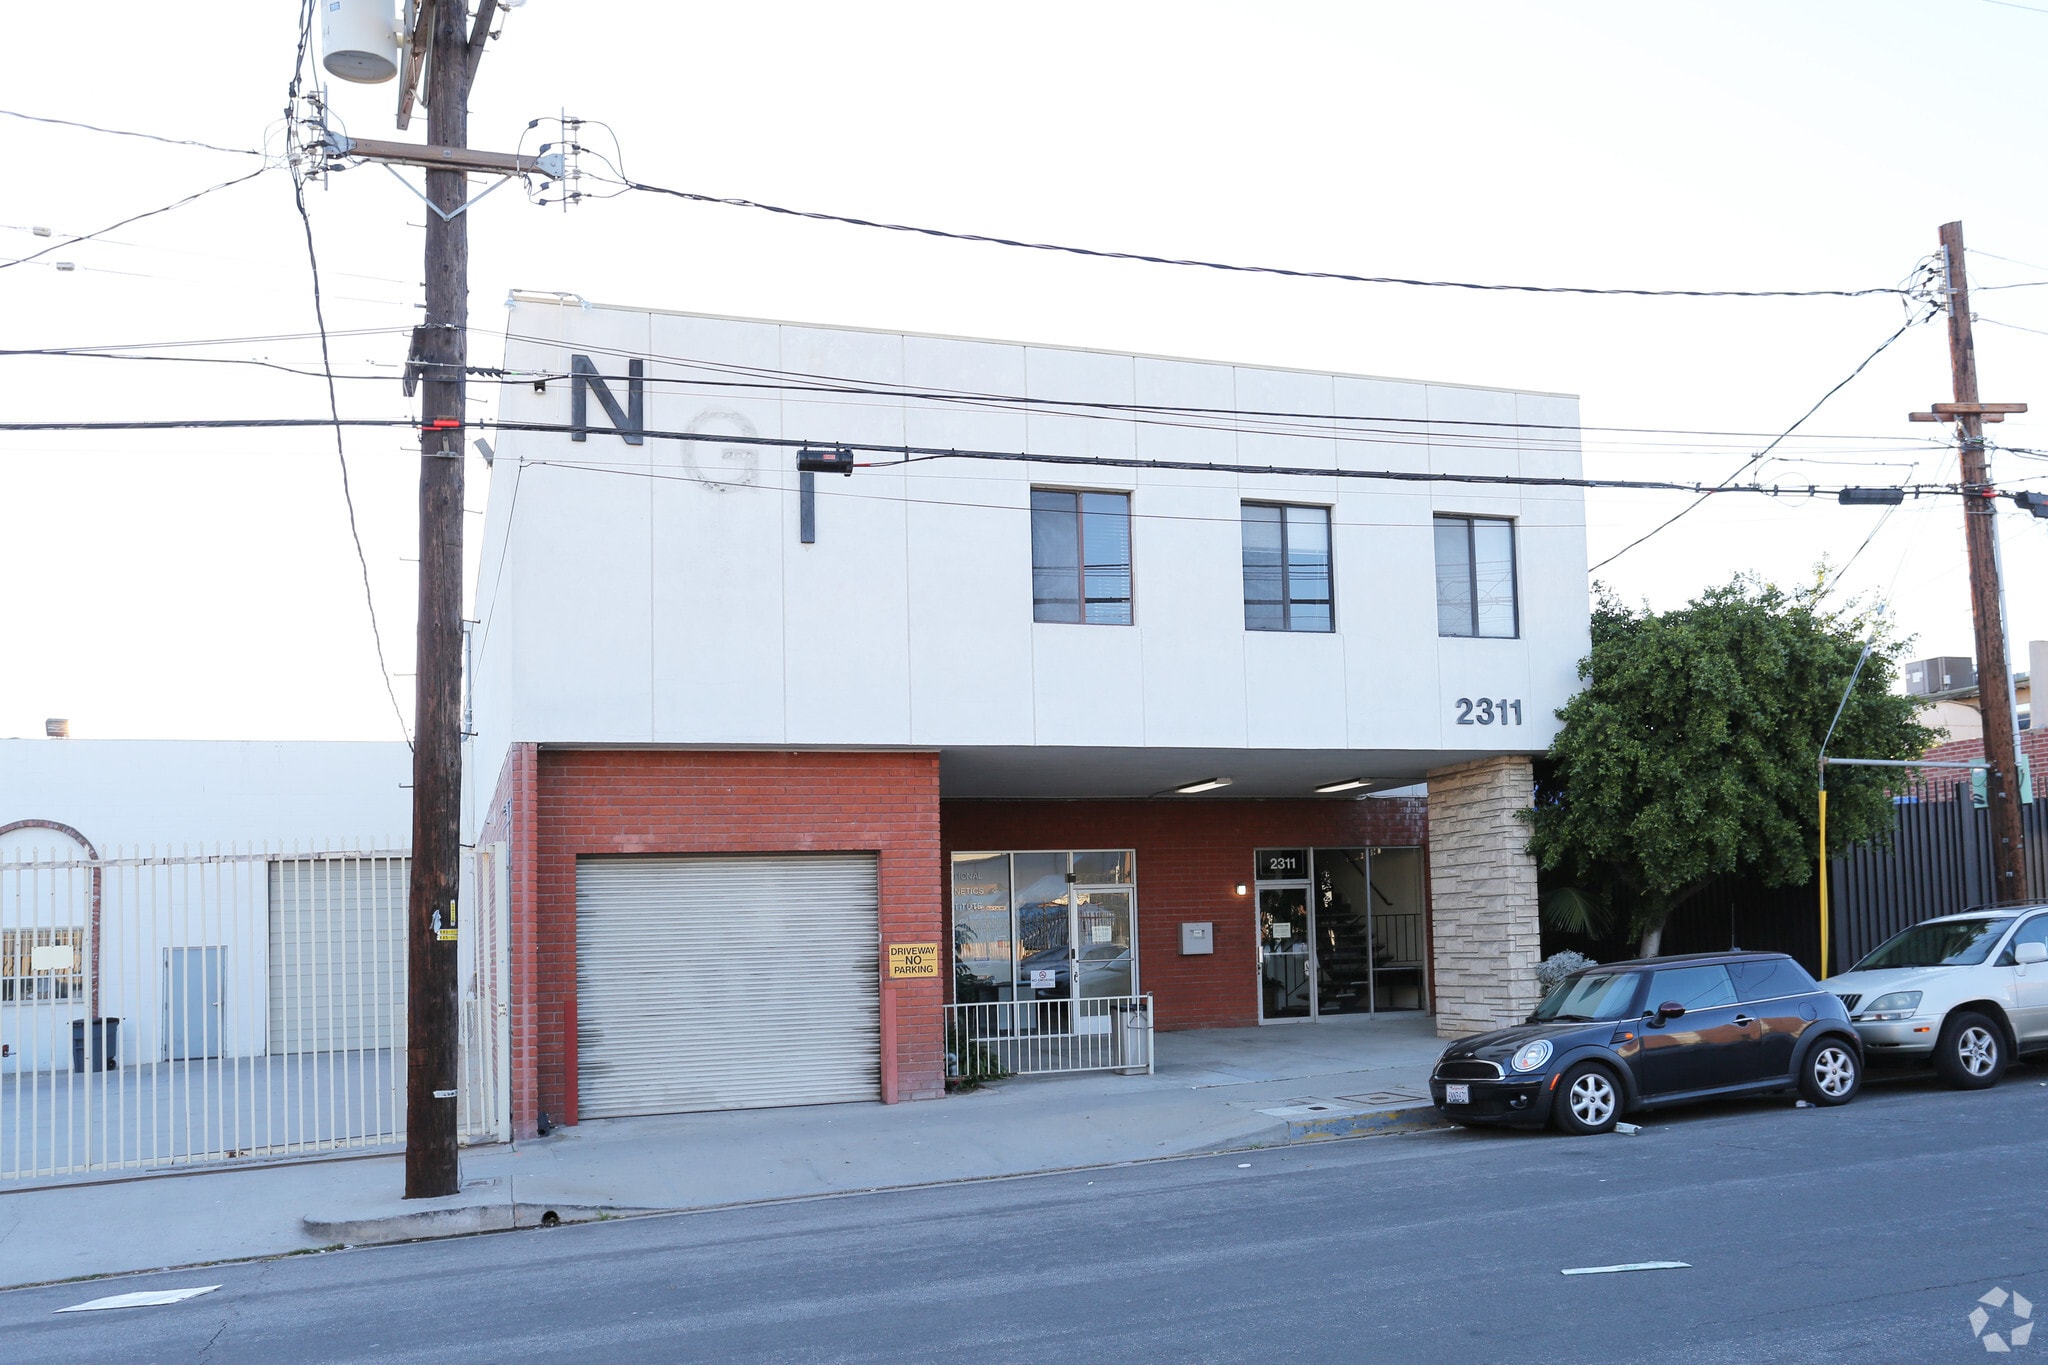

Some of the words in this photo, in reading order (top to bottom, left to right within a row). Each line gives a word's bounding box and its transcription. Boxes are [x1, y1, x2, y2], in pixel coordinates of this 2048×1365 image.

[572, 355, 643, 445] N
[1455, 697, 1522, 726] 2311
[1270, 857, 1296, 870] 2311
[890, 946, 936, 956] DRIVEWAY
[905, 955, 922, 965] NO
[894, 964, 934, 974] PARKING
